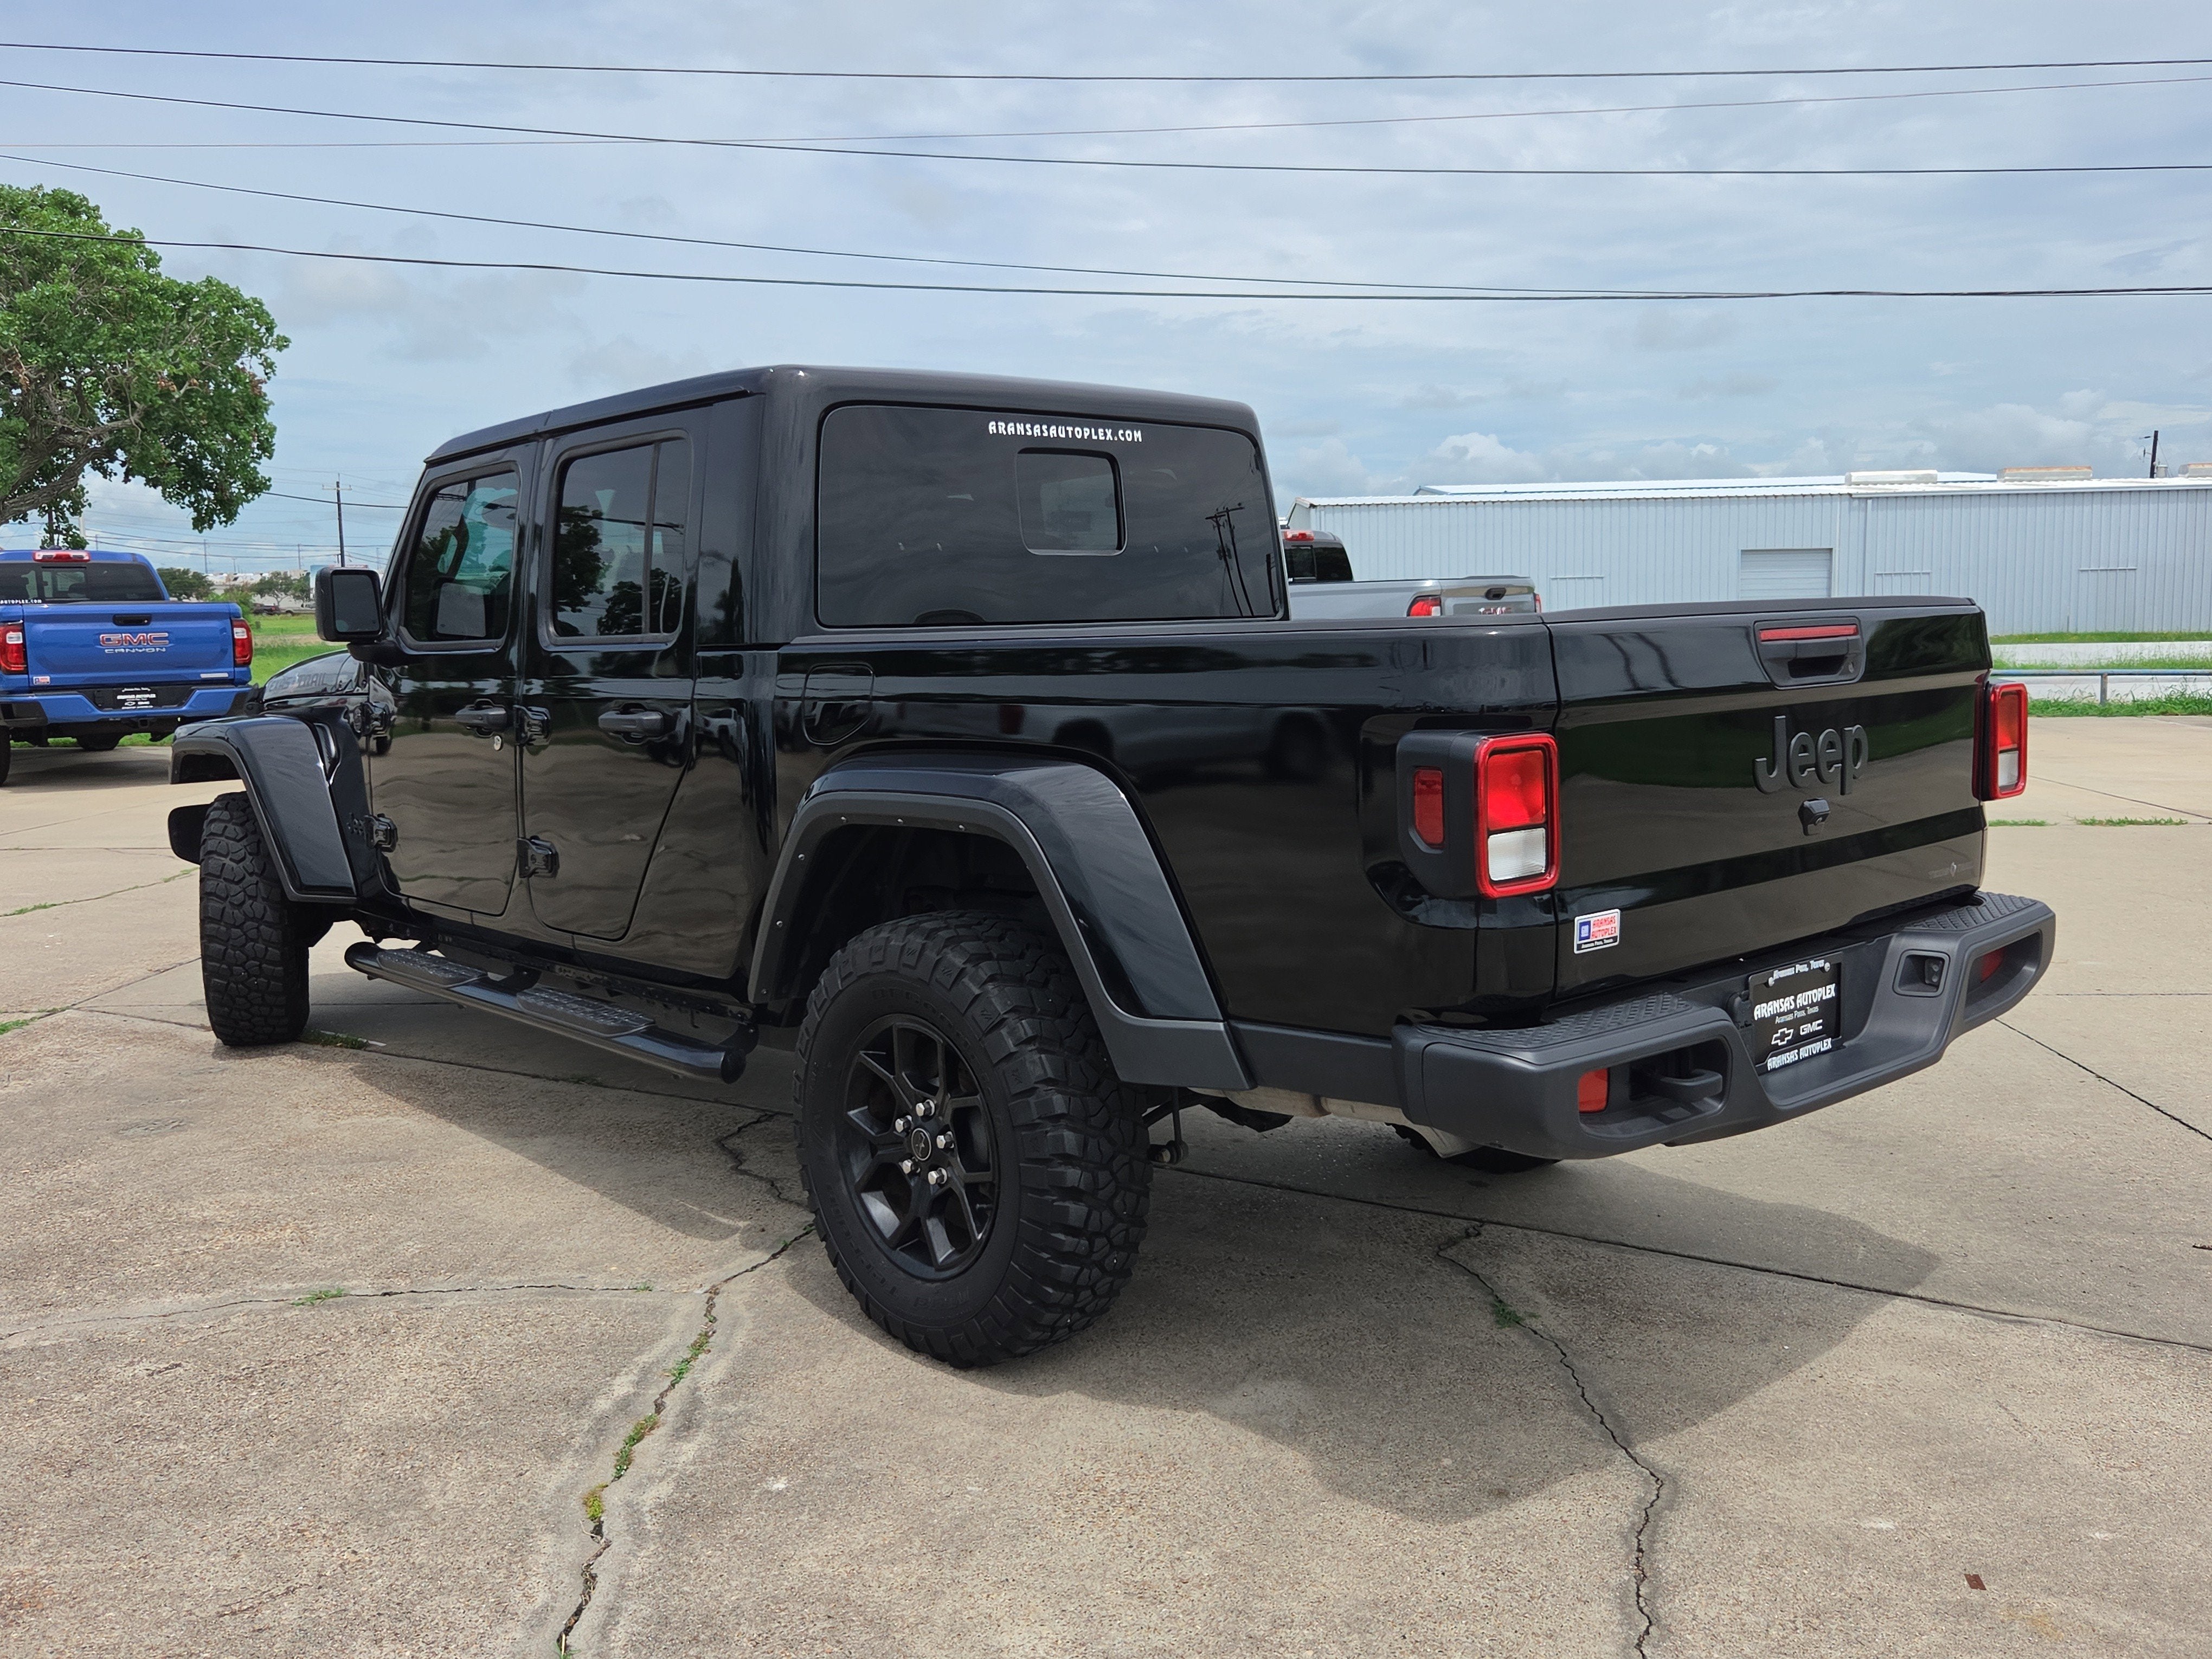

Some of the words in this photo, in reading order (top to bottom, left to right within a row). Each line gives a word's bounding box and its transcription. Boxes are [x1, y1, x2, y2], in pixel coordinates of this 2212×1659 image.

[988, 421, 1142, 442] ARANSASAUTOPLEX.COM
[100, 633, 169, 646] GMC
[1753, 715, 1869, 795] Jeep
[1754, 996, 1795, 1020] ARANSAS
[1797, 983, 1835, 1008] AUTOPLEX
[1800, 1019, 1823, 1035] GMC
[1767, 1049, 1798, 1071] ARANSAS
[1800, 1038, 1831, 1059] AUTOPLEX
